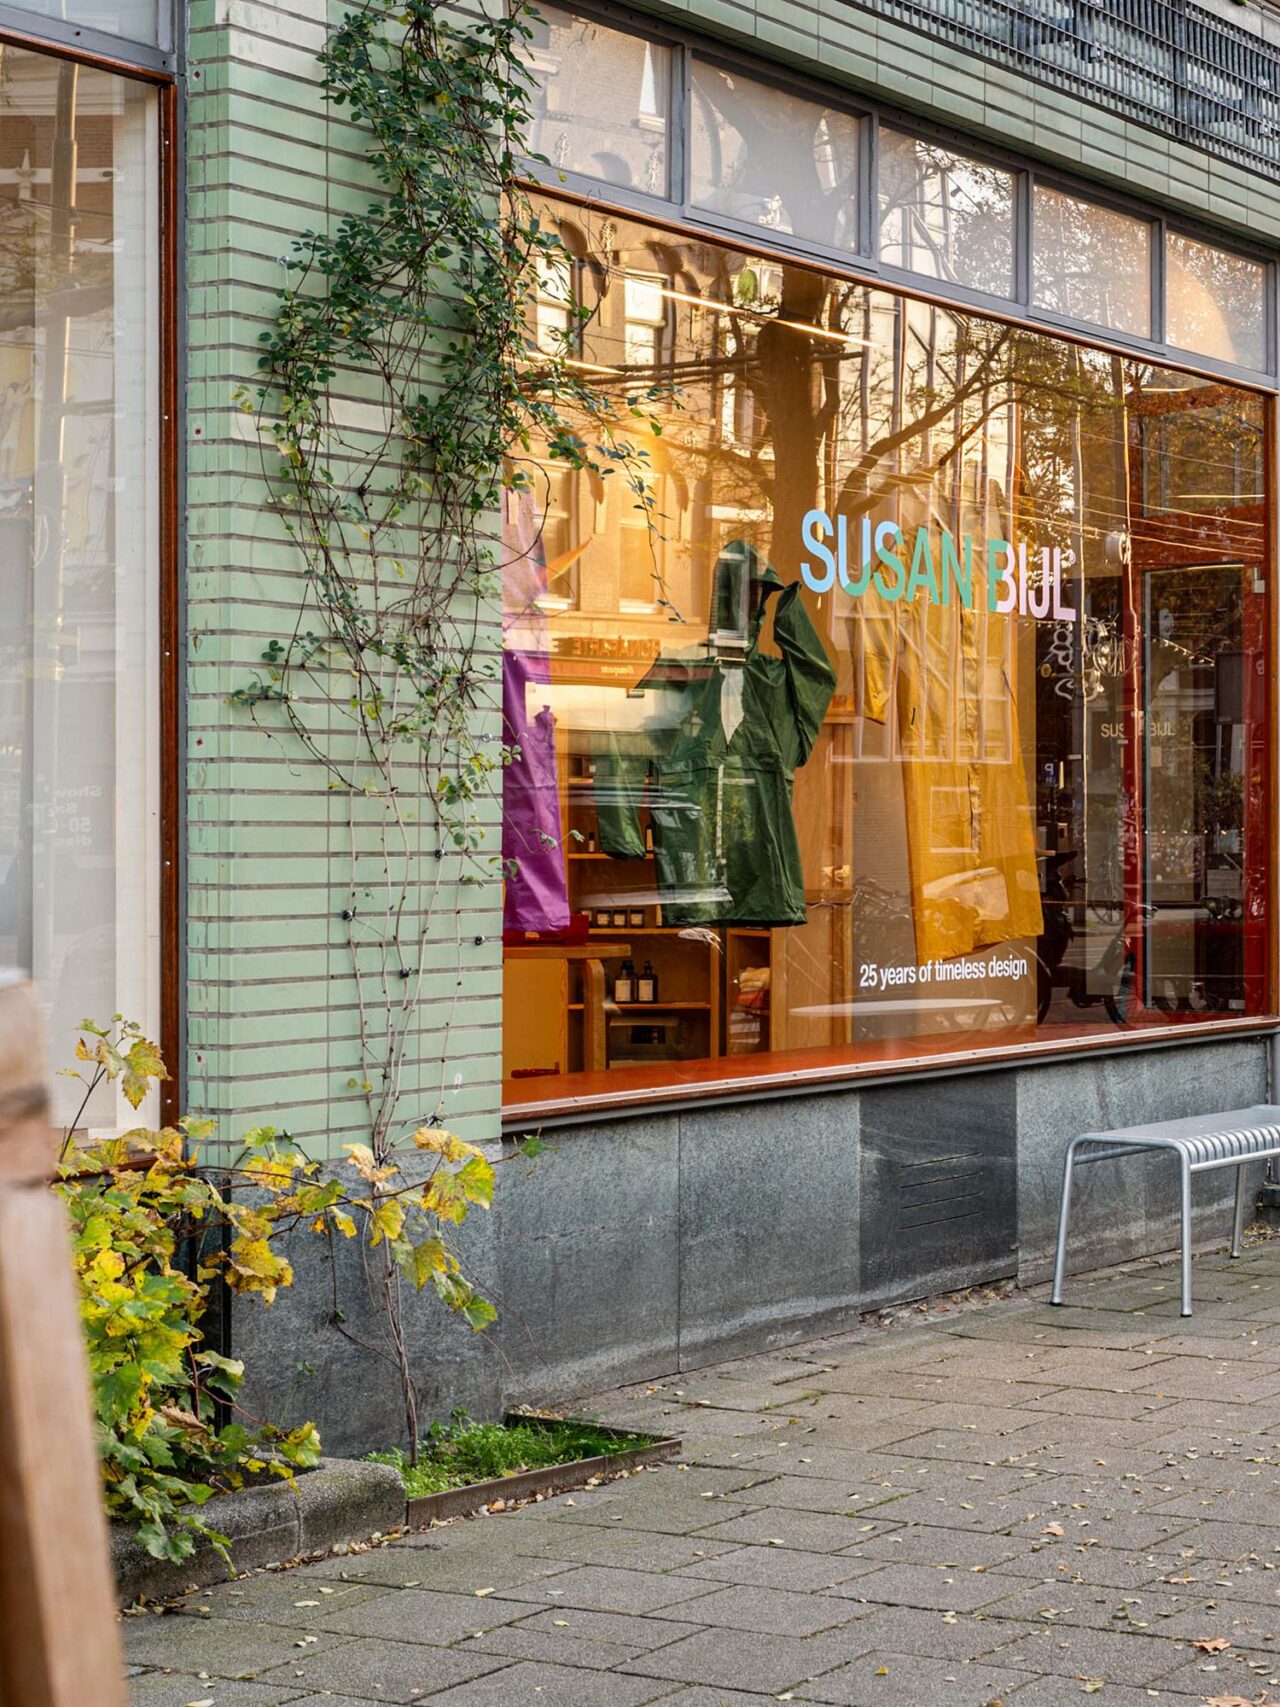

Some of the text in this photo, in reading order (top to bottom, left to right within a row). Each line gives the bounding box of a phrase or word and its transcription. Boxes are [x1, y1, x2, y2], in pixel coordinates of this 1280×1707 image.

[800, 509, 973, 609] SUSAN
[859, 955, 1028, 990] 25 years of timeless design
